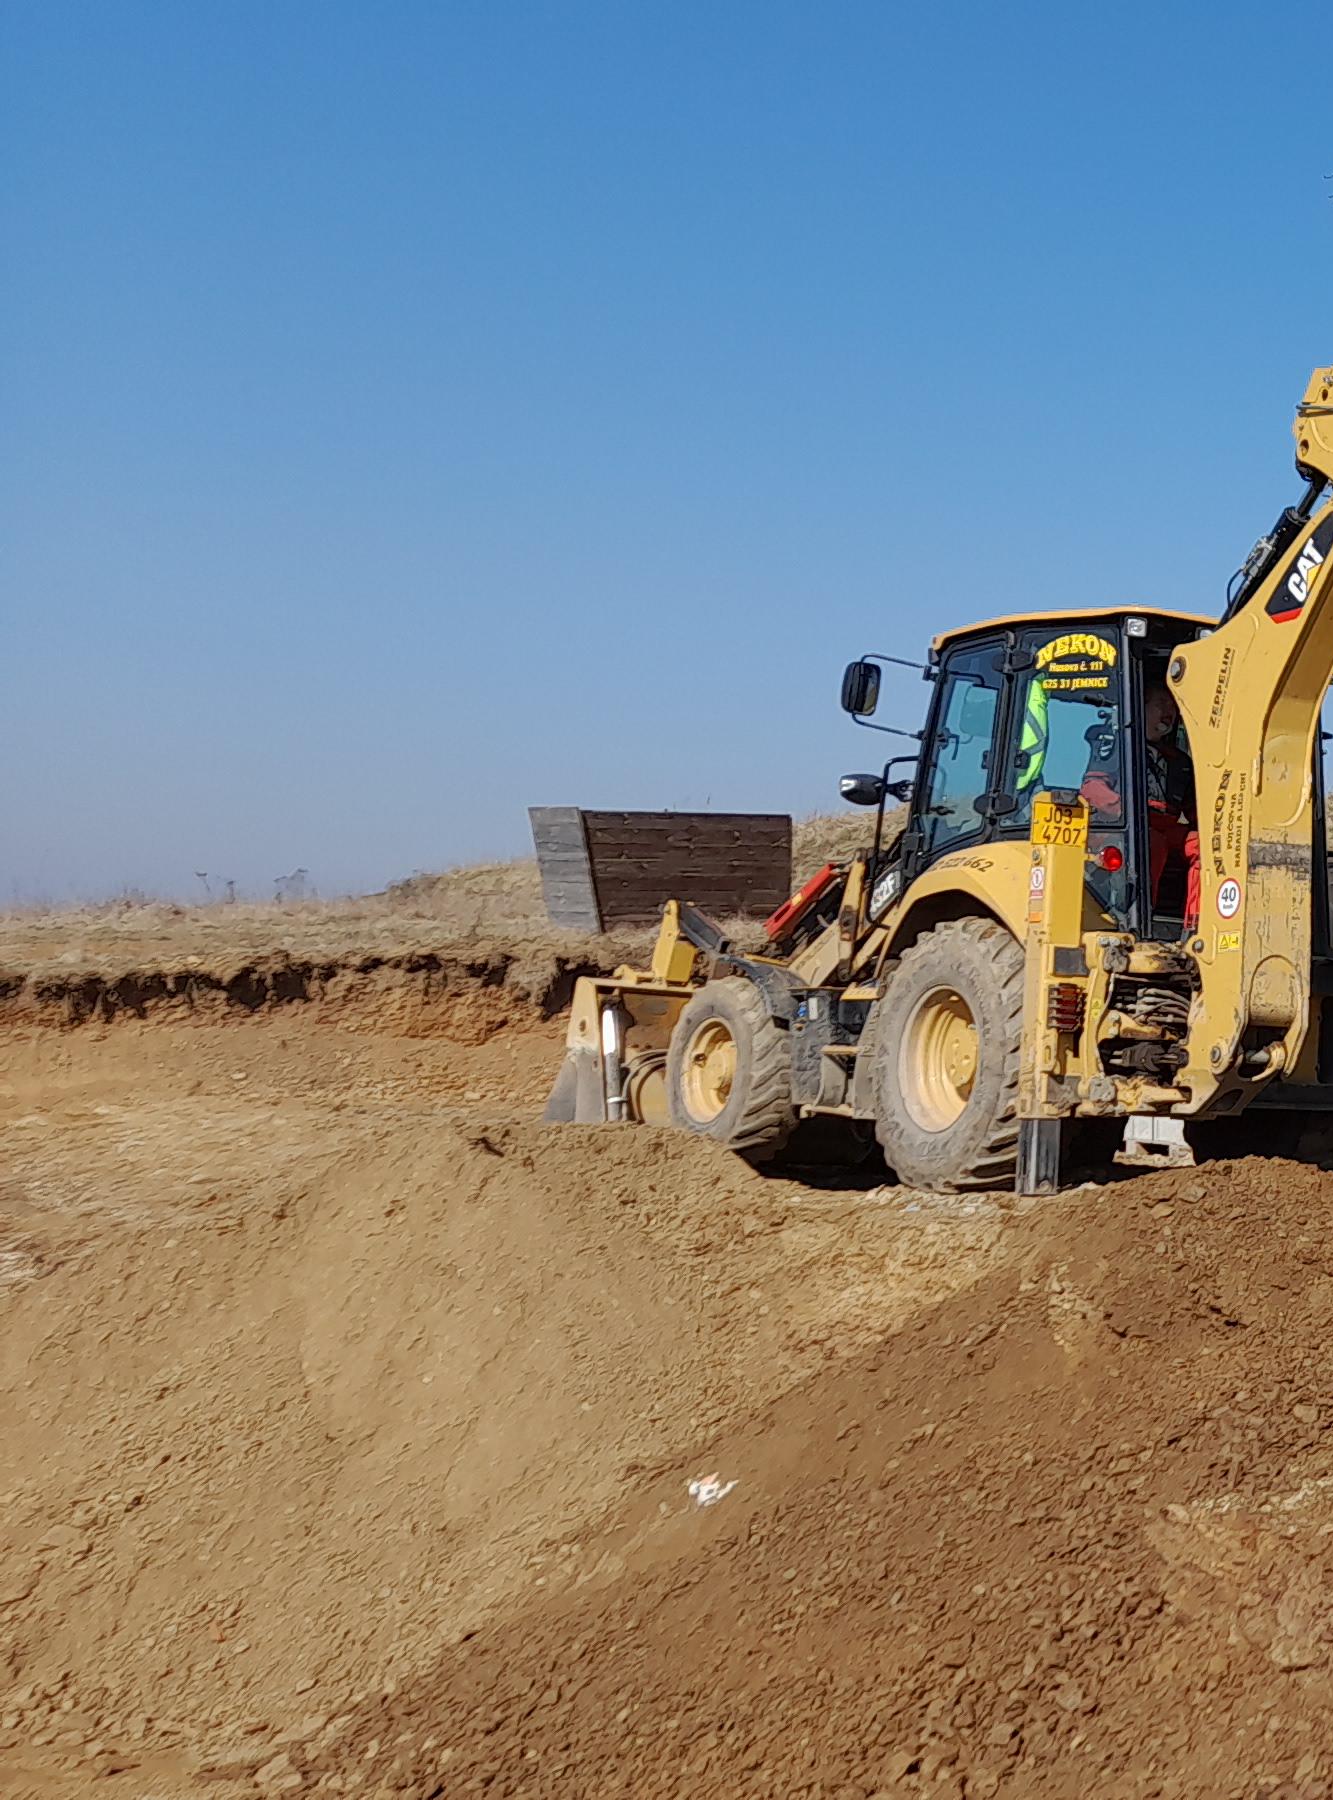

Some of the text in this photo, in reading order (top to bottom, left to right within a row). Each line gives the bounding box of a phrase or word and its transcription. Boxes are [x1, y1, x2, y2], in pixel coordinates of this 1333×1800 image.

[1288, 537, 1324, 602] CAT
[1036, 633, 1117, 670] NEKON
[1209, 647, 1231, 728] ZEPPELIN
[1044, 806, 1073, 825] J03
[1212, 769, 1232, 877] NEKON
[1043, 827, 1082, 844] 4707
[1221, 887, 1236, 902] 40
